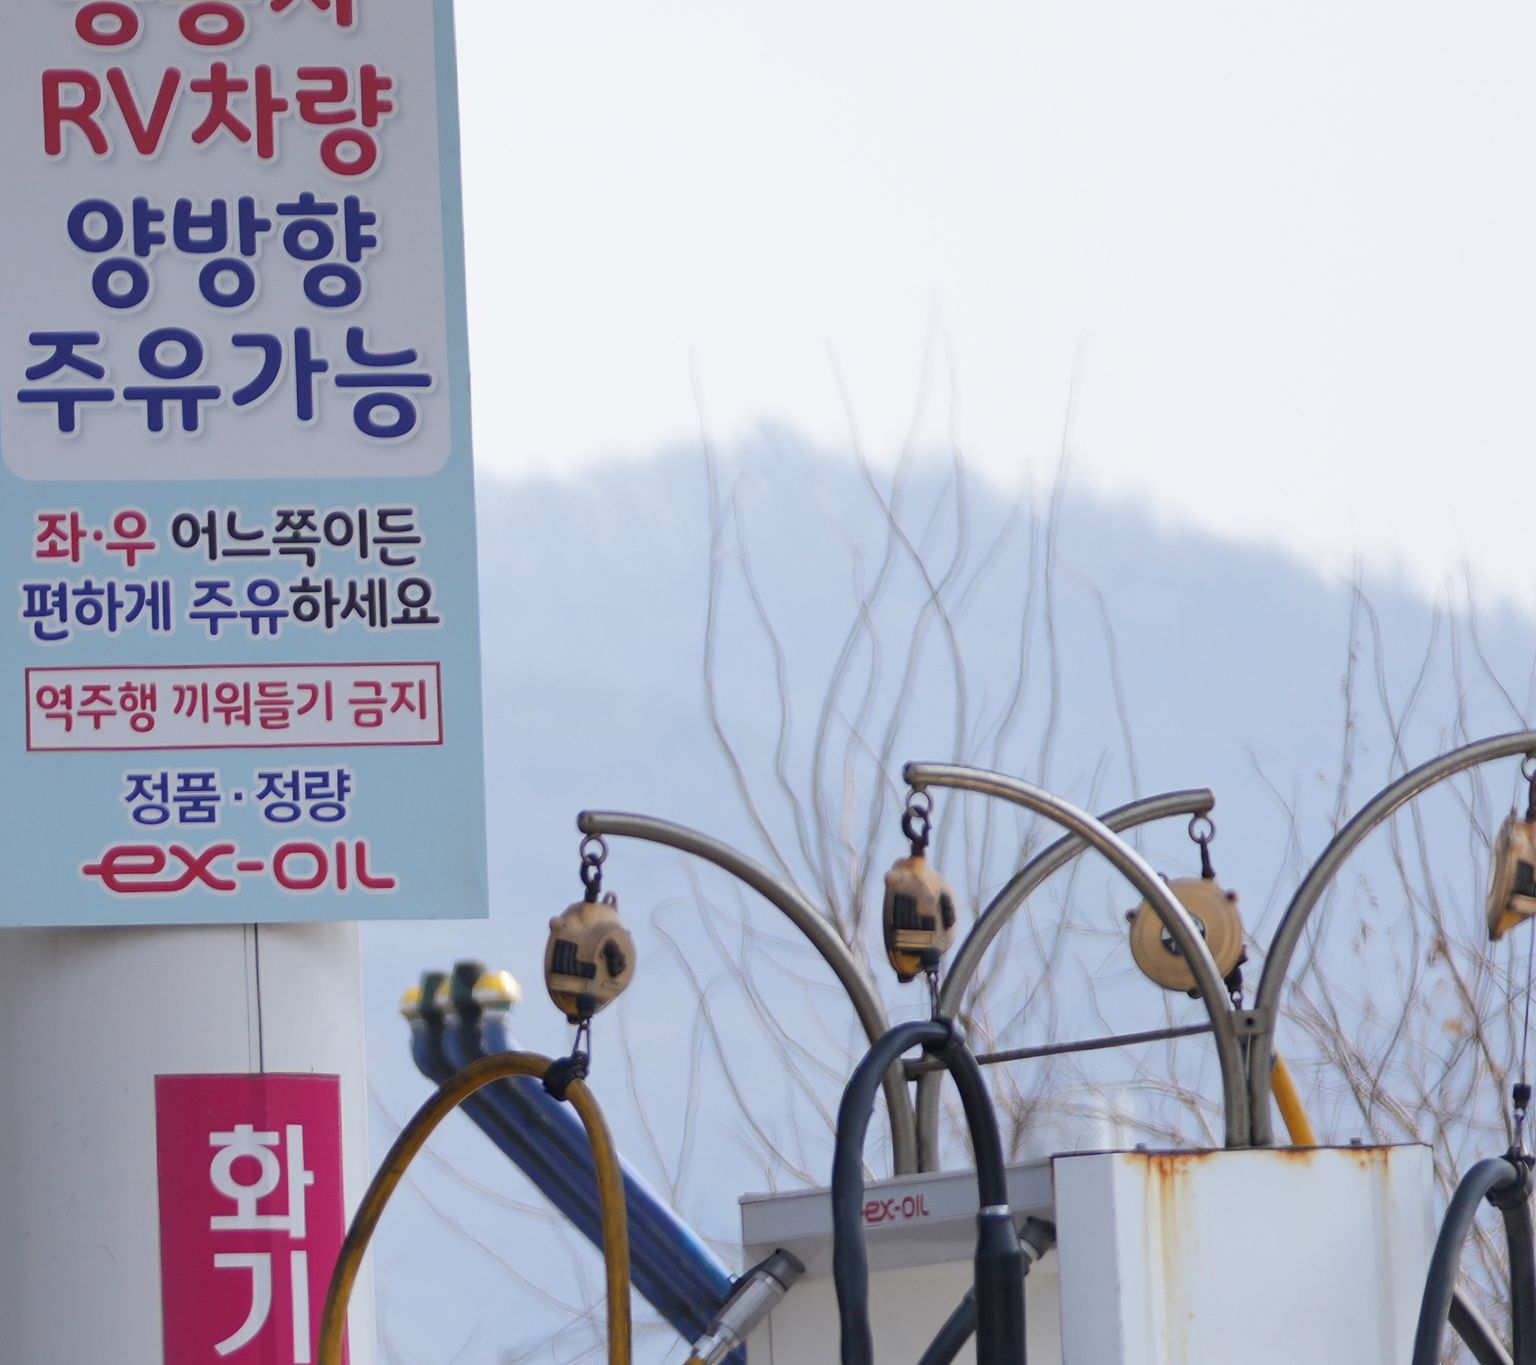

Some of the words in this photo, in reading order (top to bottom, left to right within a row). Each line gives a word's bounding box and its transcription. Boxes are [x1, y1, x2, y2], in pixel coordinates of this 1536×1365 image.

[41, 61, 392, 177] RV차량
[67, 190, 378, 308] 양방향
[17, 326, 433, 438] 주유가능
[171, 506, 422, 567] 어느쪽이든
[22, 578, 171, 641] 편하게
[189, 576, 440, 638] 주유하세요
[35, 681, 158, 733] 역주행
[172, 681, 333, 730] 끼워들기
[347, 680, 428, 727] 금지
